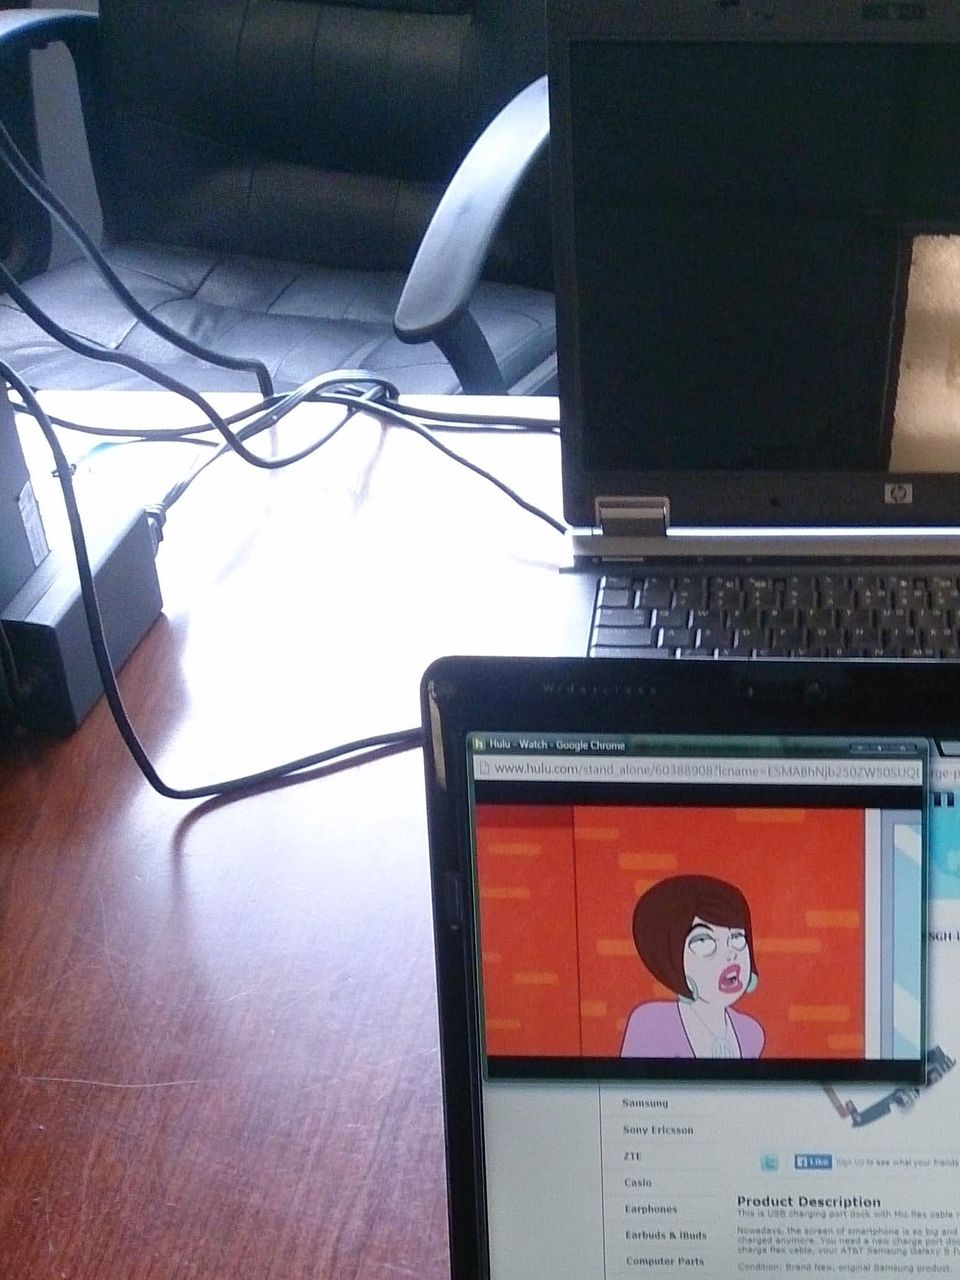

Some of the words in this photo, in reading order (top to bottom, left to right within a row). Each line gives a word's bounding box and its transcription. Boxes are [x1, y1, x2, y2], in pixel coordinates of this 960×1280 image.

[490, 739, 511, 749] Hulu
[519, 740, 547, 749] Watch
[556, 740, 588, 752] Google
[590, 741, 625, 751] Chrome
[622, 1099, 669, 1109] Samsung
[623, 1125, 648, 1136] Sony
[651, 1125, 694, 1135] Ericsson
[624, 1179, 652, 1187] Casio
[737, 1195, 794, 1208] Product
[798, 1195, 882, 1210] Description
[625, 1205, 678, 1215] Earphones
[625, 1230, 667, 1240] Earbuds
[626, 1257, 675, 1267] Computer
[678, 1257, 704, 1266] Parts
